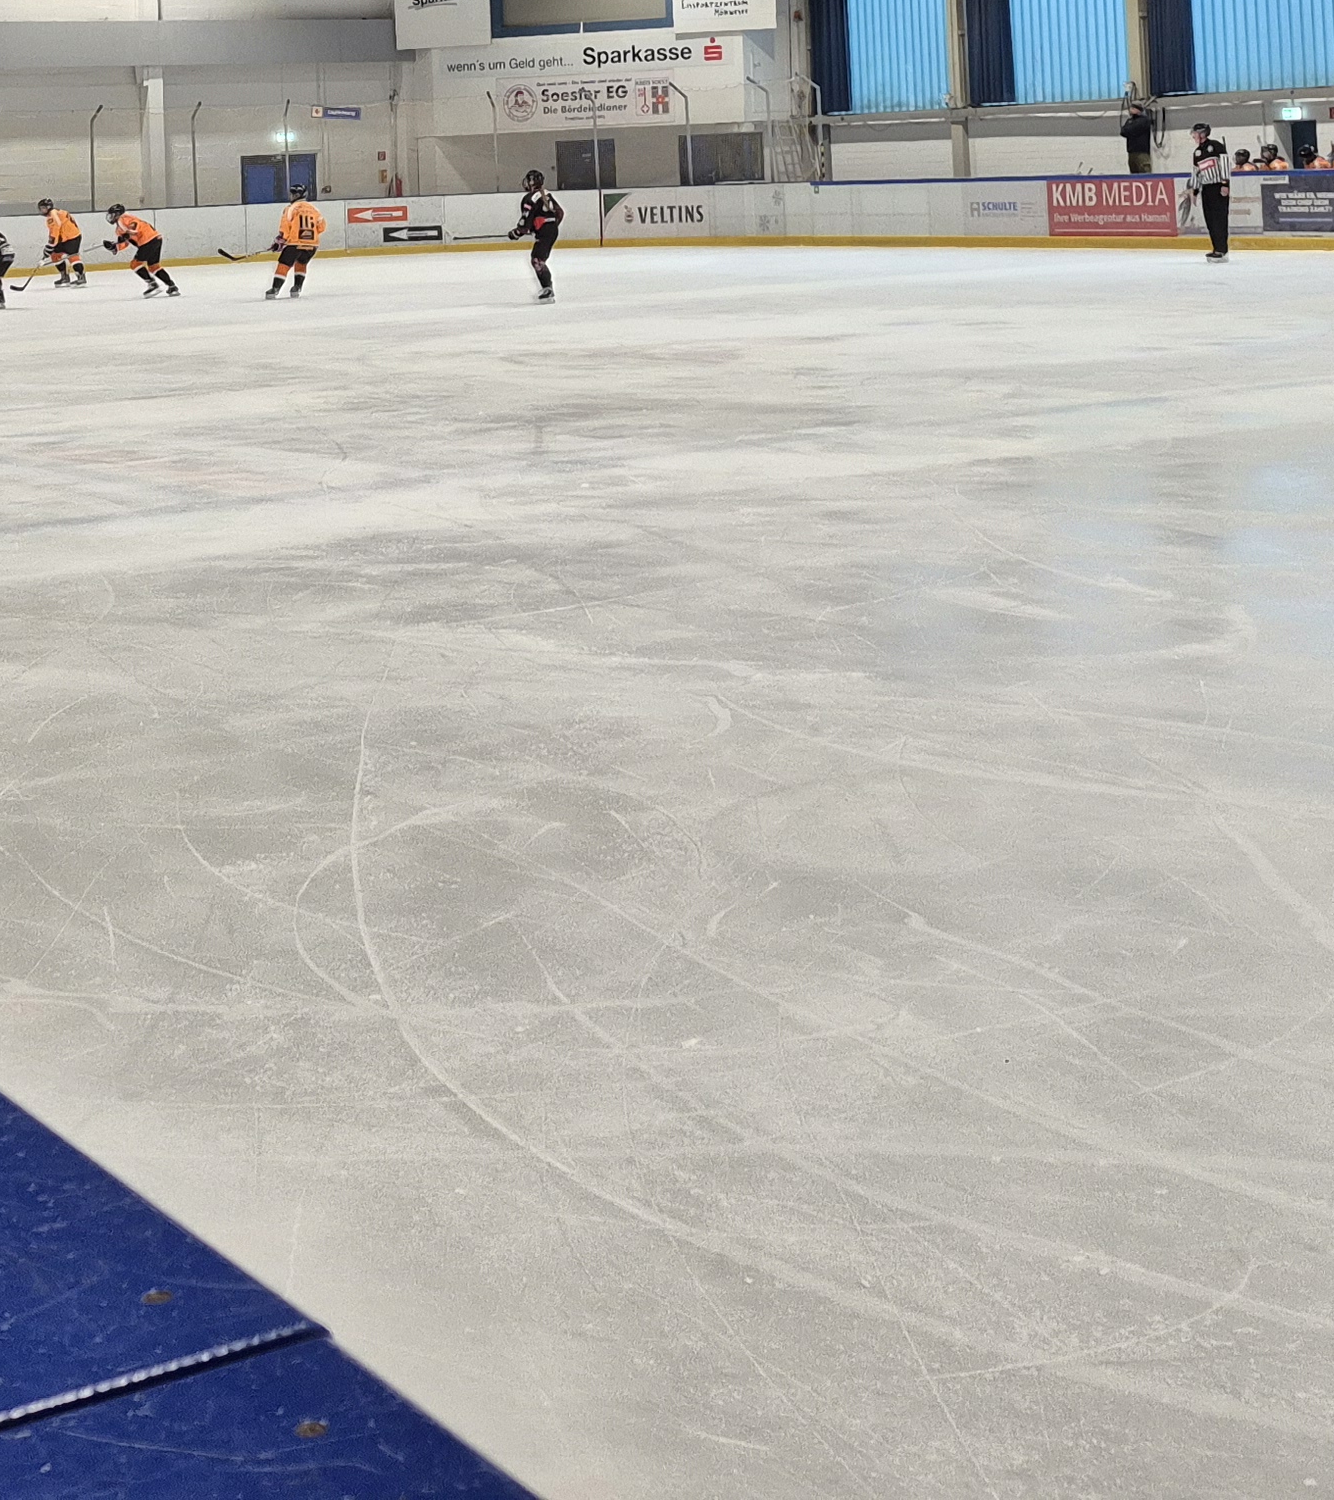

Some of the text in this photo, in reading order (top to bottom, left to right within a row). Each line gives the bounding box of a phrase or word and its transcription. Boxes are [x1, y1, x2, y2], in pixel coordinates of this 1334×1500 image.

[488, 61, 506, 71] um
[509, 57, 536, 70] Geld
[538, 56, 574, 72] geht...
[582, 45, 692, 68] Sparkasse
[606, 85, 629, 100] EG
[543, 106, 558, 115] Die
[1052, 181, 1170, 207] KMB MEDIA
[981, 201, 1018, 211] SCHULTE
[637, 204, 704, 224] VELTINS
[1053, 213, 1070, 223] Ihre
[1070, 213, 1125, 225] Werbeagentur
[1126, 214, 1140, 223] aus
